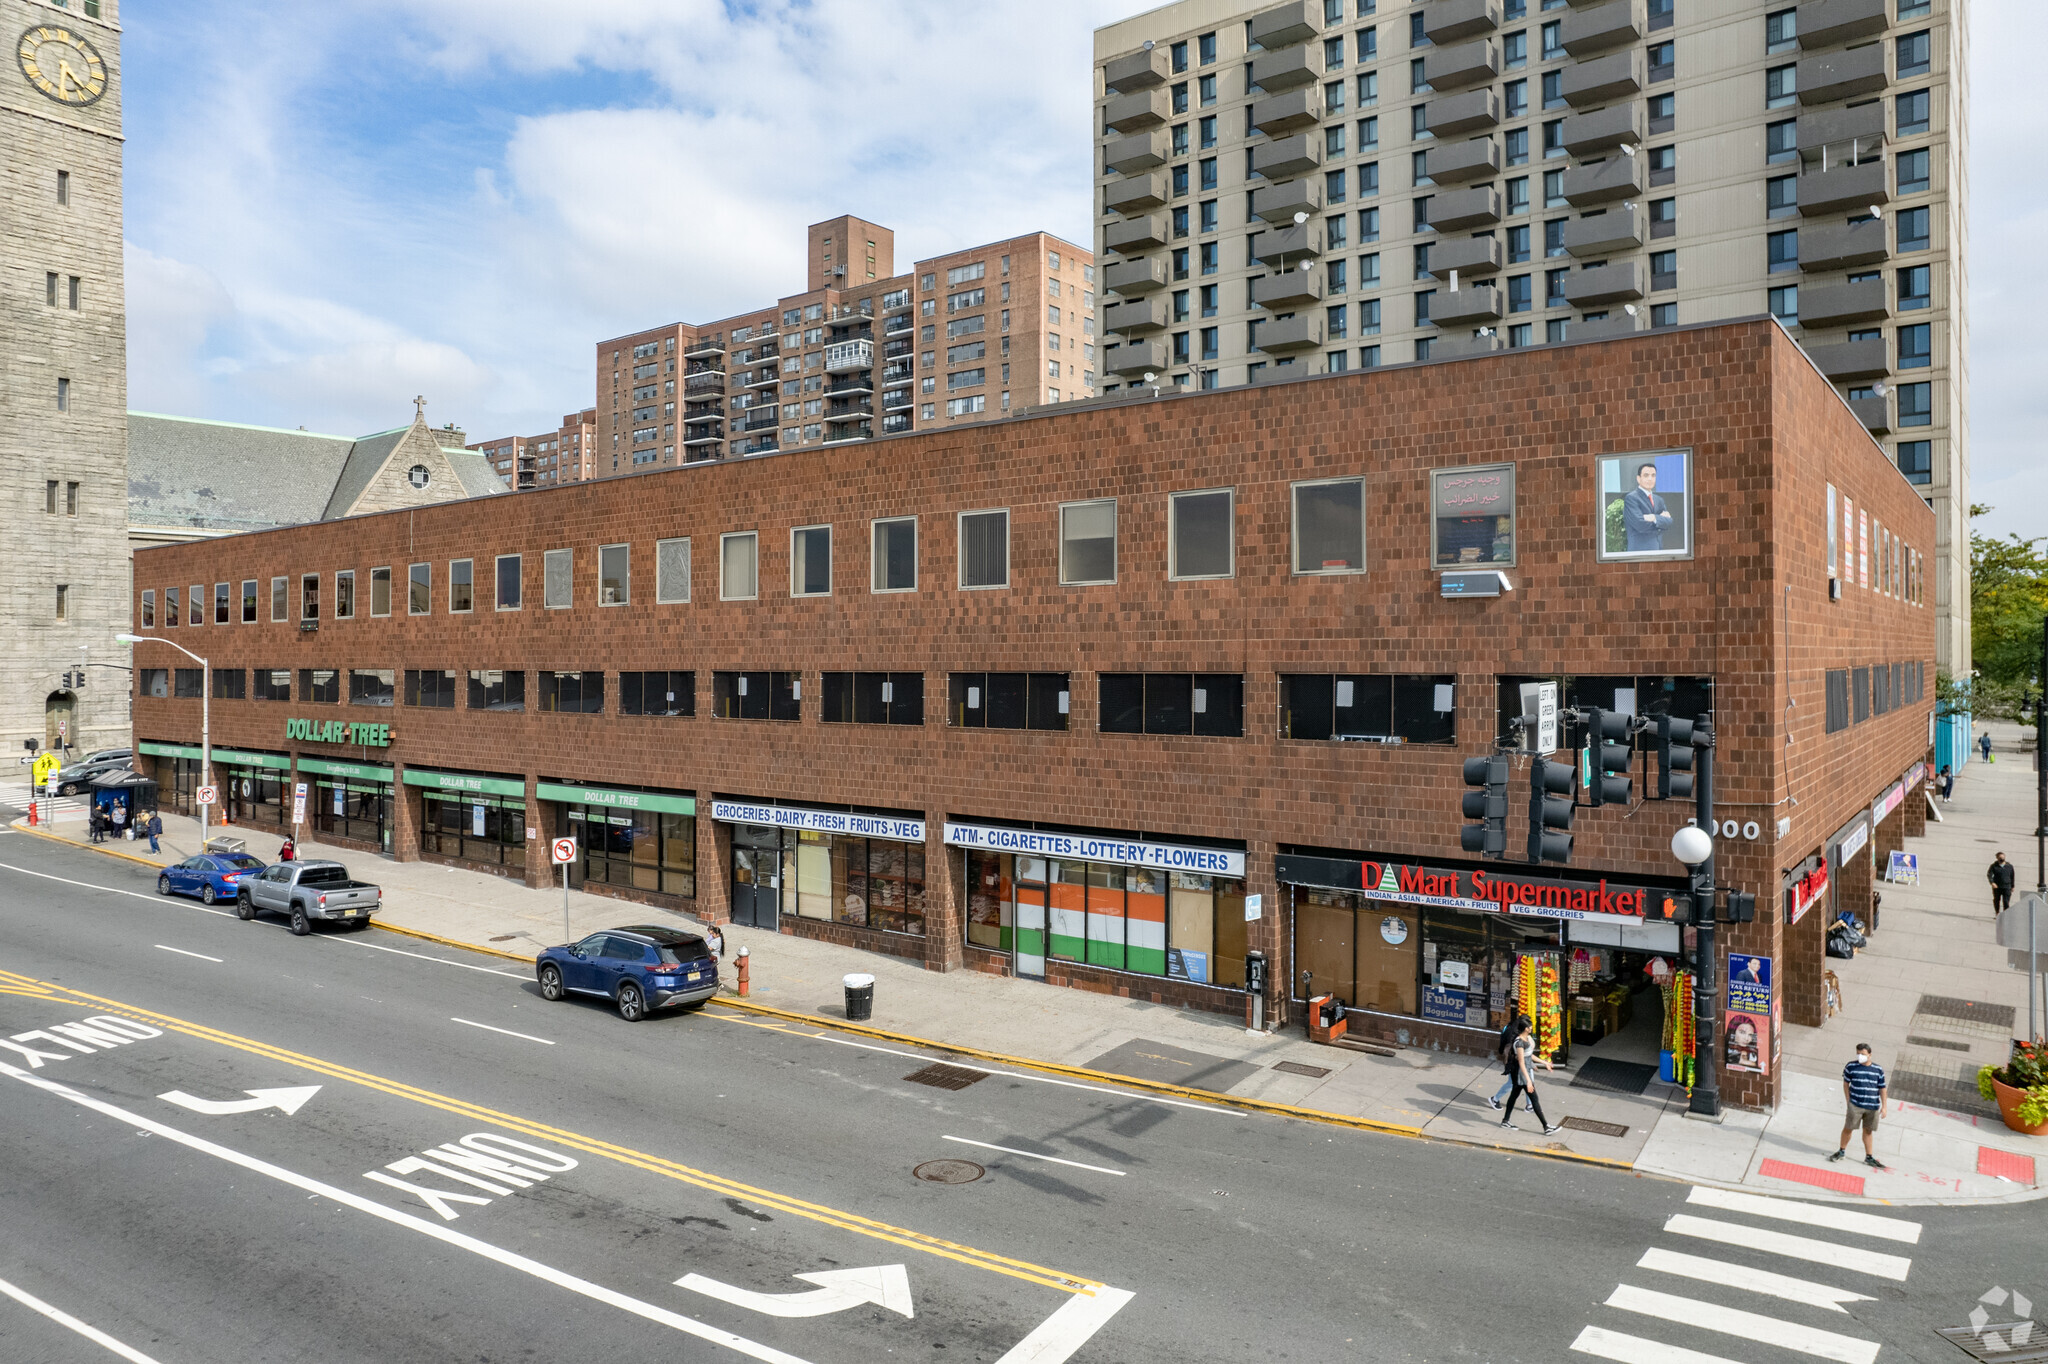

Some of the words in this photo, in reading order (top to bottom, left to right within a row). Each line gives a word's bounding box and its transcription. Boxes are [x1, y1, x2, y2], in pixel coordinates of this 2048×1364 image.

[1443, 478, 1475, 489] جرجس
[1478, 476, 1501, 486] وجيه
[1443, 493, 1478, 507] الضرائب
[1480, 491, 1500, 504] خبير
[1540, 689, 1549, 701] LEFT
[1550, 688, 1556, 697] ON
[1541, 705, 1554, 716] GREEN
[1541, 719, 1554, 732] ARROW
[286, 718, 345, 744] DOLLAR
[349, 722, 390, 748] TREE
[1542, 735, 1553, 747] ONLY
[235, 754, 252, 763] DOLLAR
[252, 756, 263, 764] TREE
[440, 776, 464, 788] DOLLAR
[466, 780, 482, 790] TREE
[584, 792, 616, 804] DOLLAR
[618, 795, 639, 806] TREE
[1472, 868, 1647, 917] Supermarket
[1366, 890, 1392, 900] INDIAN
[1398, 894, 1421, 903] ASIAN
[1426, 897, 1466, 908] AMERICAN
[1472, 901, 1499, 912] FRUITS
[1514, 905, 1530, 914] VEG
[1536, 908, 1584, 920] GROCERIES
[1425, 991, 1464, 1010] Fulop
[1492, 998, 1504, 1006] YES
[1425, 1006, 1464, 1019] Boggiano
[362, 1132, 579, 1221] ONLY
